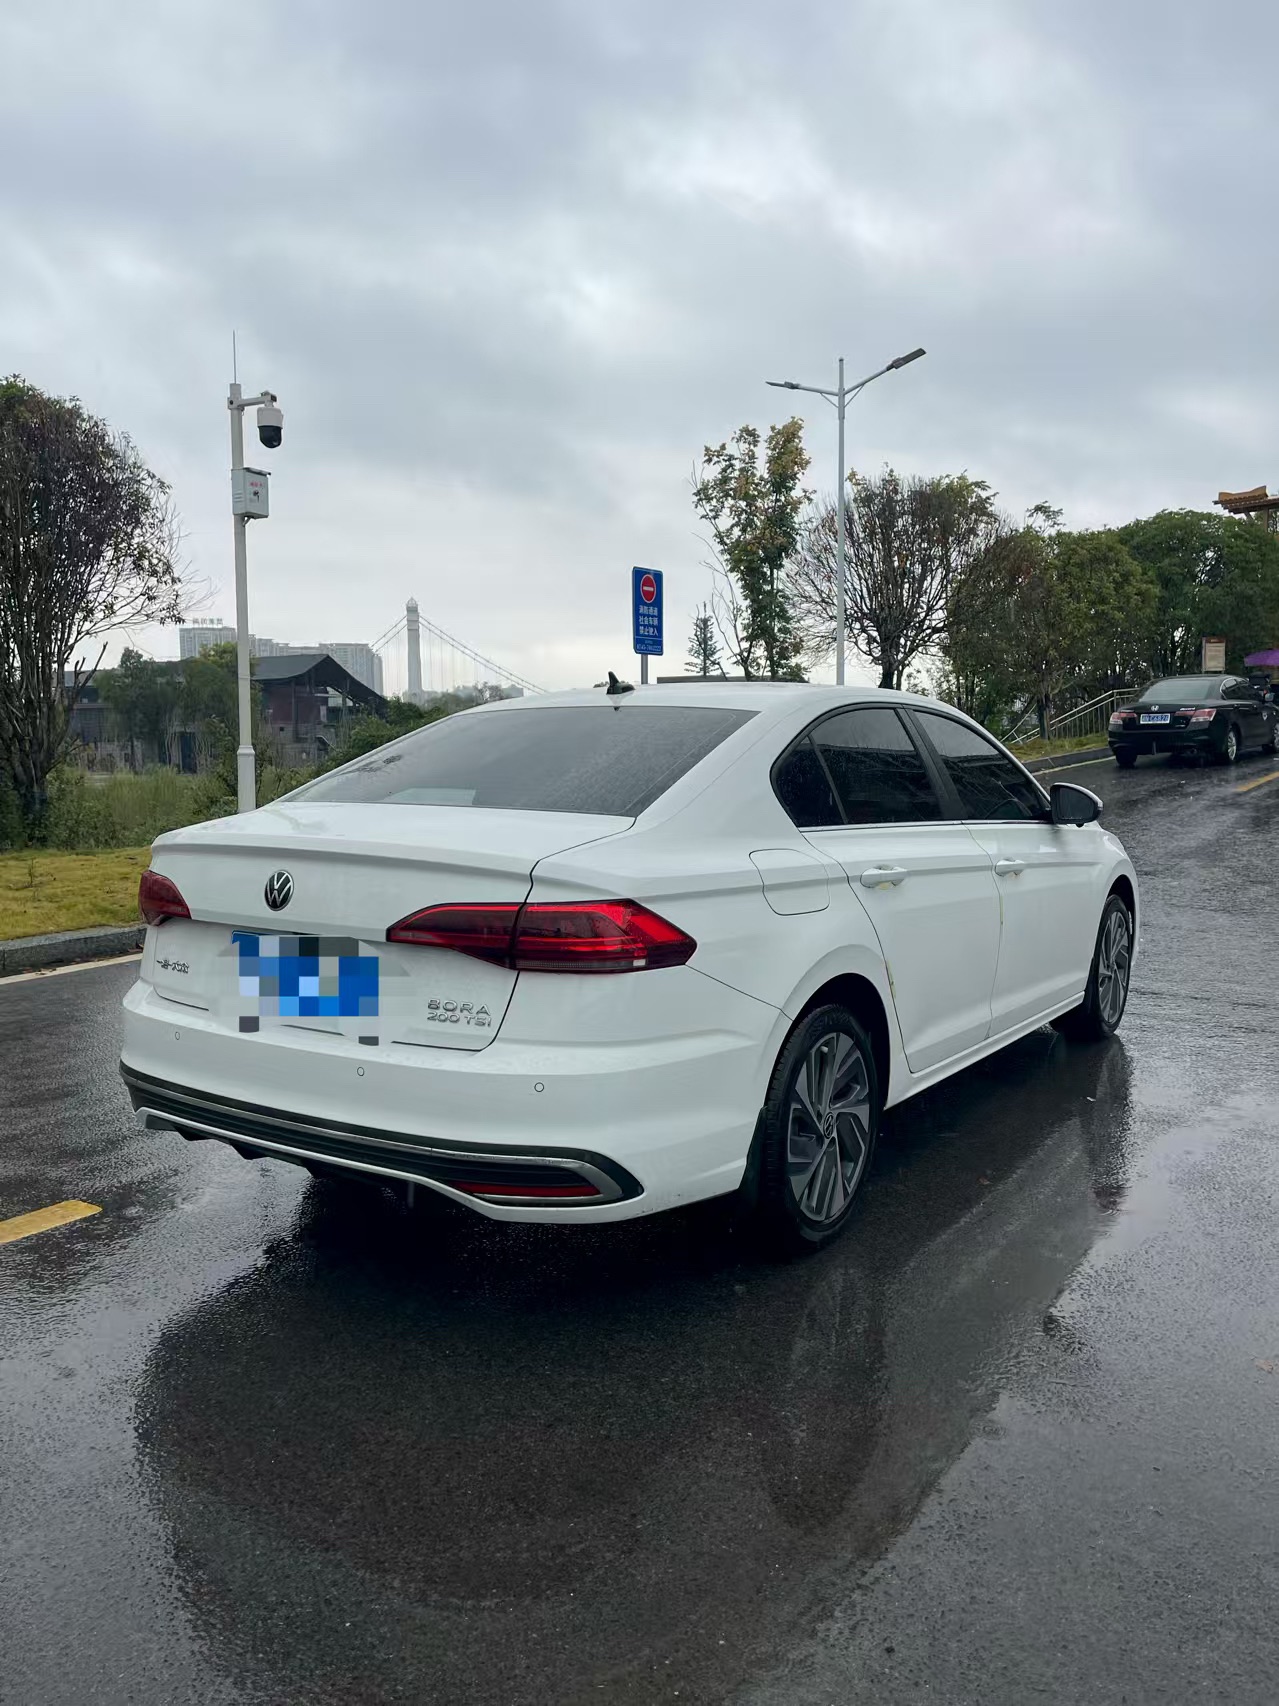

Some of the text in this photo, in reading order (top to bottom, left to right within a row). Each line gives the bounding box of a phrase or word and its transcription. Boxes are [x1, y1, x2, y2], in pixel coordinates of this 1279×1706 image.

[639, 616, 658, 626] 社会车辆
[639, 626, 658, 636] 禁止驶入
[428, 998, 491, 1016] BORA
[427, 1011, 492, 1027] 200 TSI
